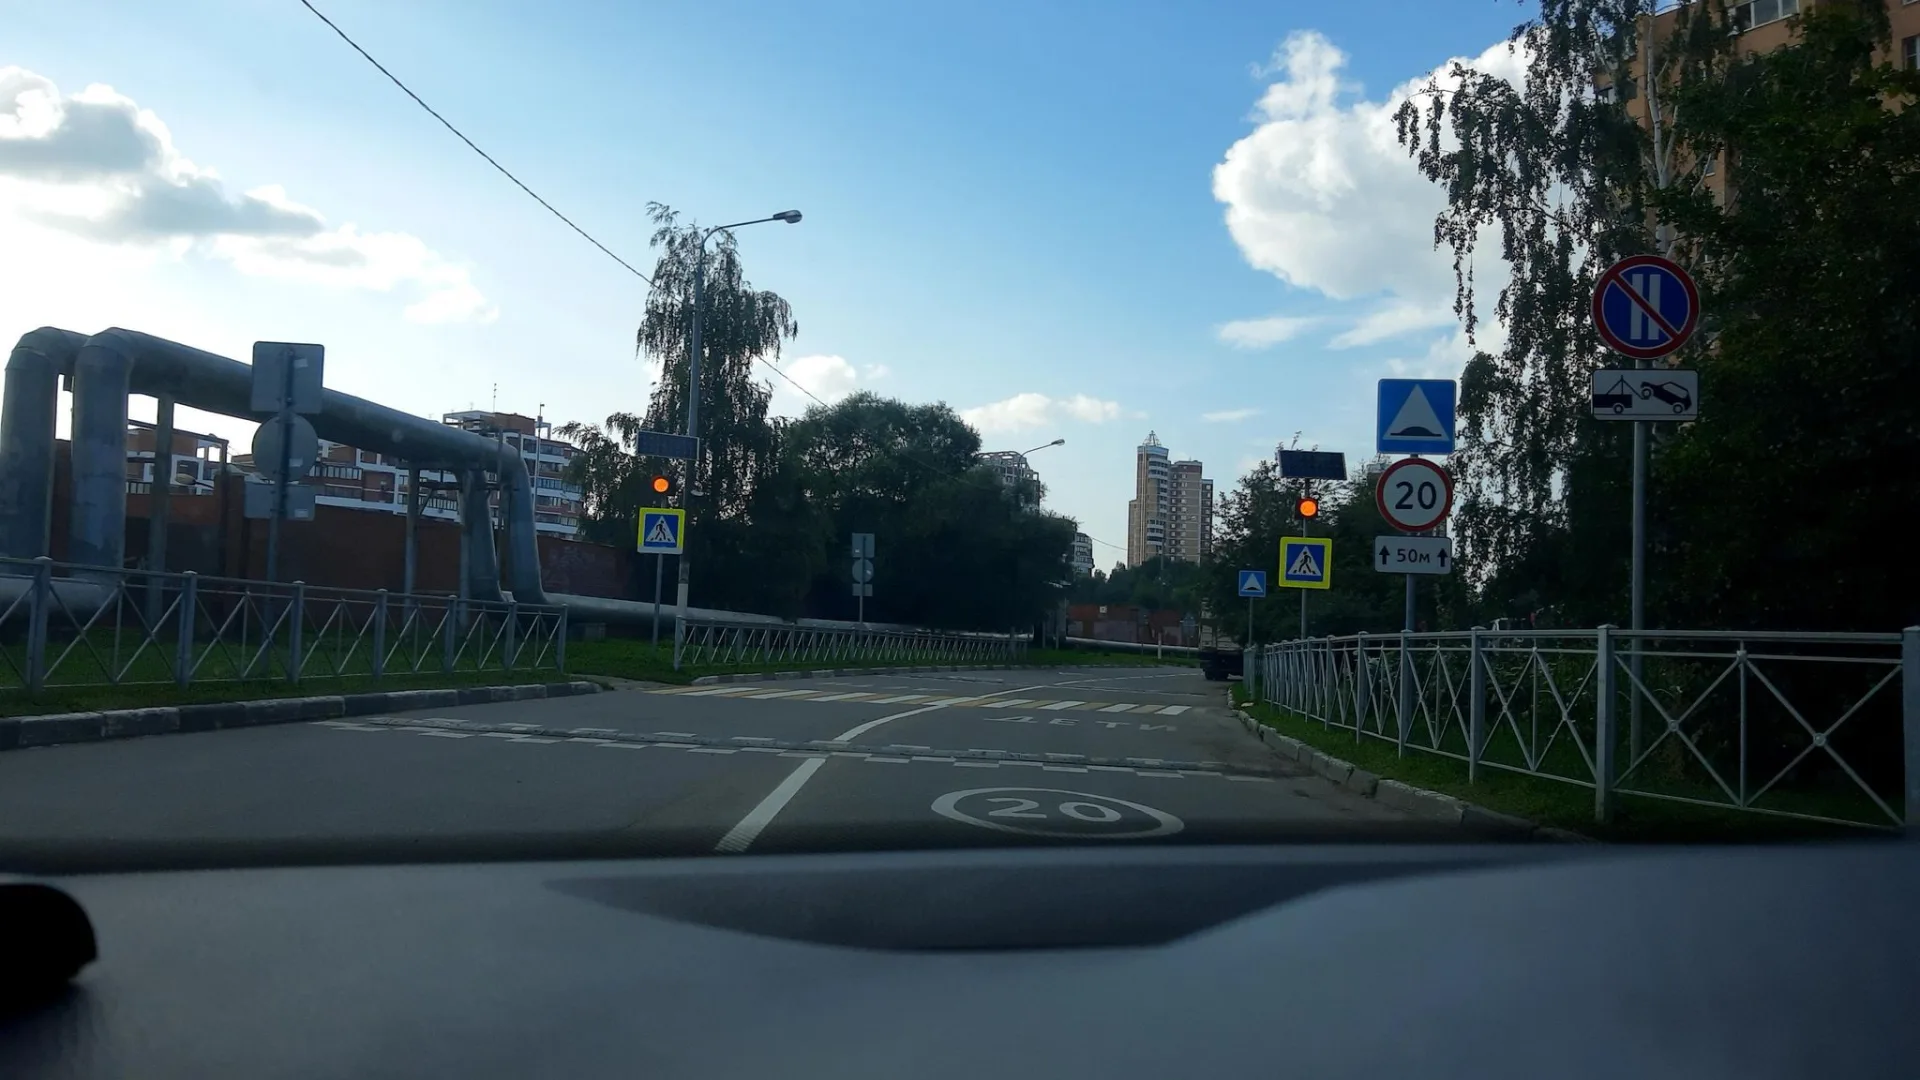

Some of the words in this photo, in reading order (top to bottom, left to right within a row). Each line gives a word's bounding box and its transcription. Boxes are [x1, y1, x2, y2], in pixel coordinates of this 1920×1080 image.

[1395, 481, 1437, 510] 20
[983, 715, 1177, 731] ДЕТИ
[986, 797, 1122, 823] 20
